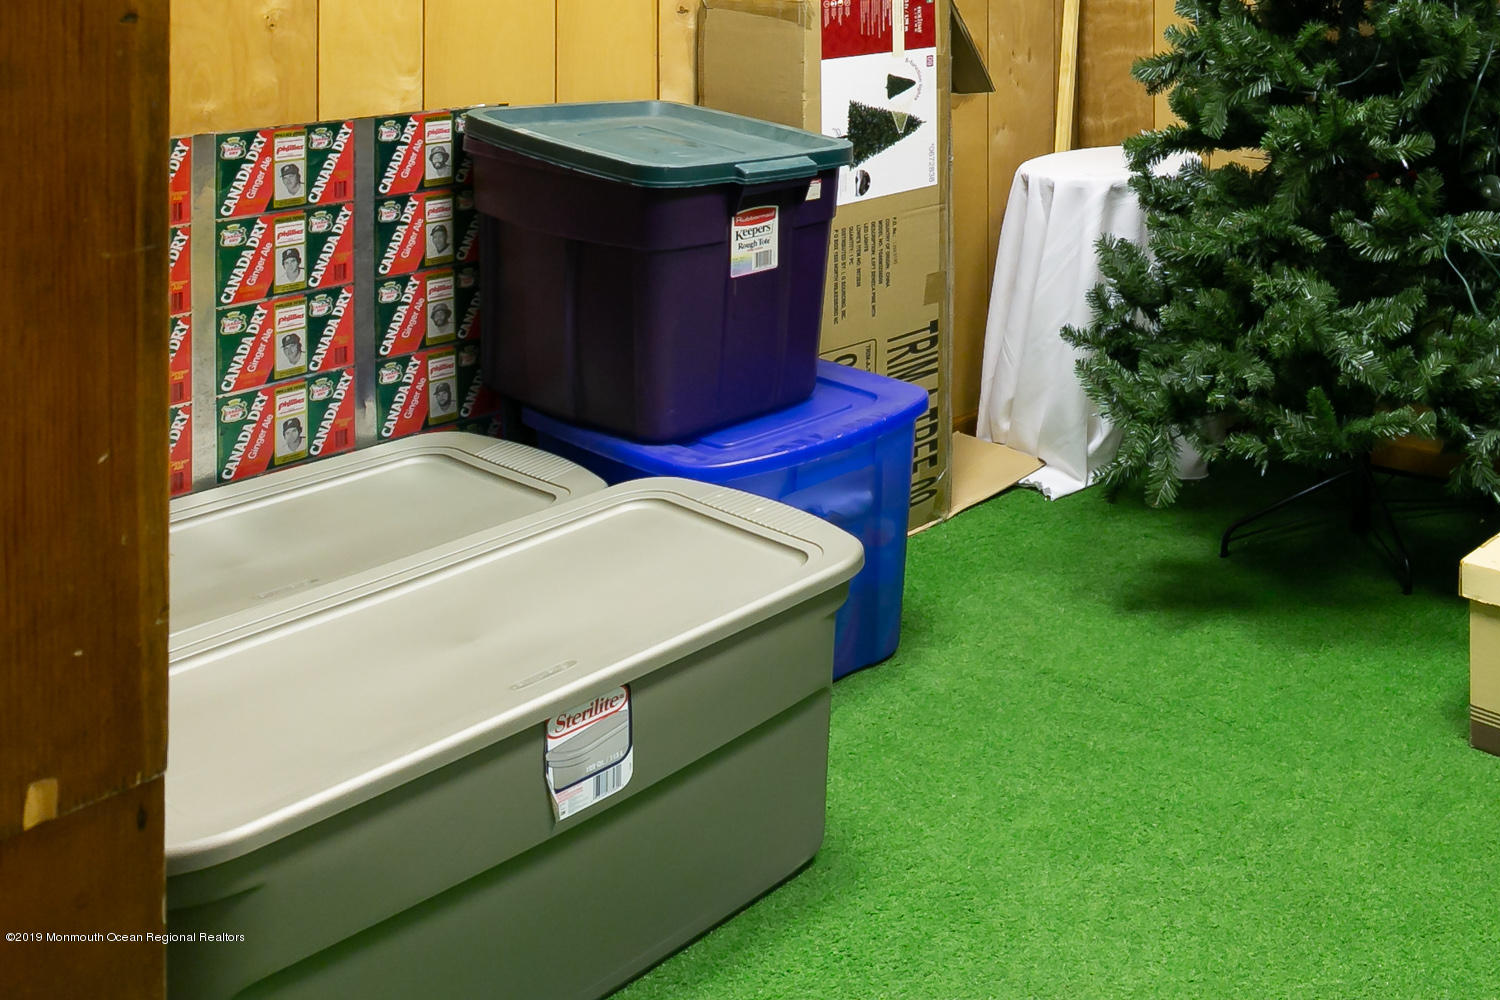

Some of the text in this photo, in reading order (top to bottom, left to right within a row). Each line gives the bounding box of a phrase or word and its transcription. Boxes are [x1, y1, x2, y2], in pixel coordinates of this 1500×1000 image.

[221, 132, 268, 216] CANADA DRY
[246, 156, 272, 199] Ginger Ale
[308, 123, 352, 204] CANADA DRY
[378, 143, 406, 194] CANADA
[400, 116, 419, 147] DRY
[400, 138, 423, 179] Ginger Ale
[221, 218, 268, 303] CANADA DRY
[246, 242, 273, 286] Ginger Ale
[308, 206, 352, 288] CANADA DRY
[378, 224, 406, 275] CANADA
[400, 196, 419, 227] DRY
[400, 218, 424, 259] Ginger Ale
[735, 225, 771, 241] Keepers
[738, 240, 758, 250] Rough
[221, 305, 268, 392] CANADA DRY
[247, 328, 273, 372] Ginger Ale
[309, 288, 352, 371] CANADA DRY
[379, 306, 407, 356] CANADA
[401, 276, 420, 307] DRY
[402, 297, 425, 339] Ginger Ale
[222, 391, 269, 480] CANADA DRY
[310, 371, 353, 456] CANADA DRY
[381, 386, 409, 438] CANADA
[402, 356, 421, 387] DRY
[404, 377, 426, 419] Ginger Ale
[248, 414, 273, 460] Ginger Ale
[555, 695, 619, 733] Sterilite
